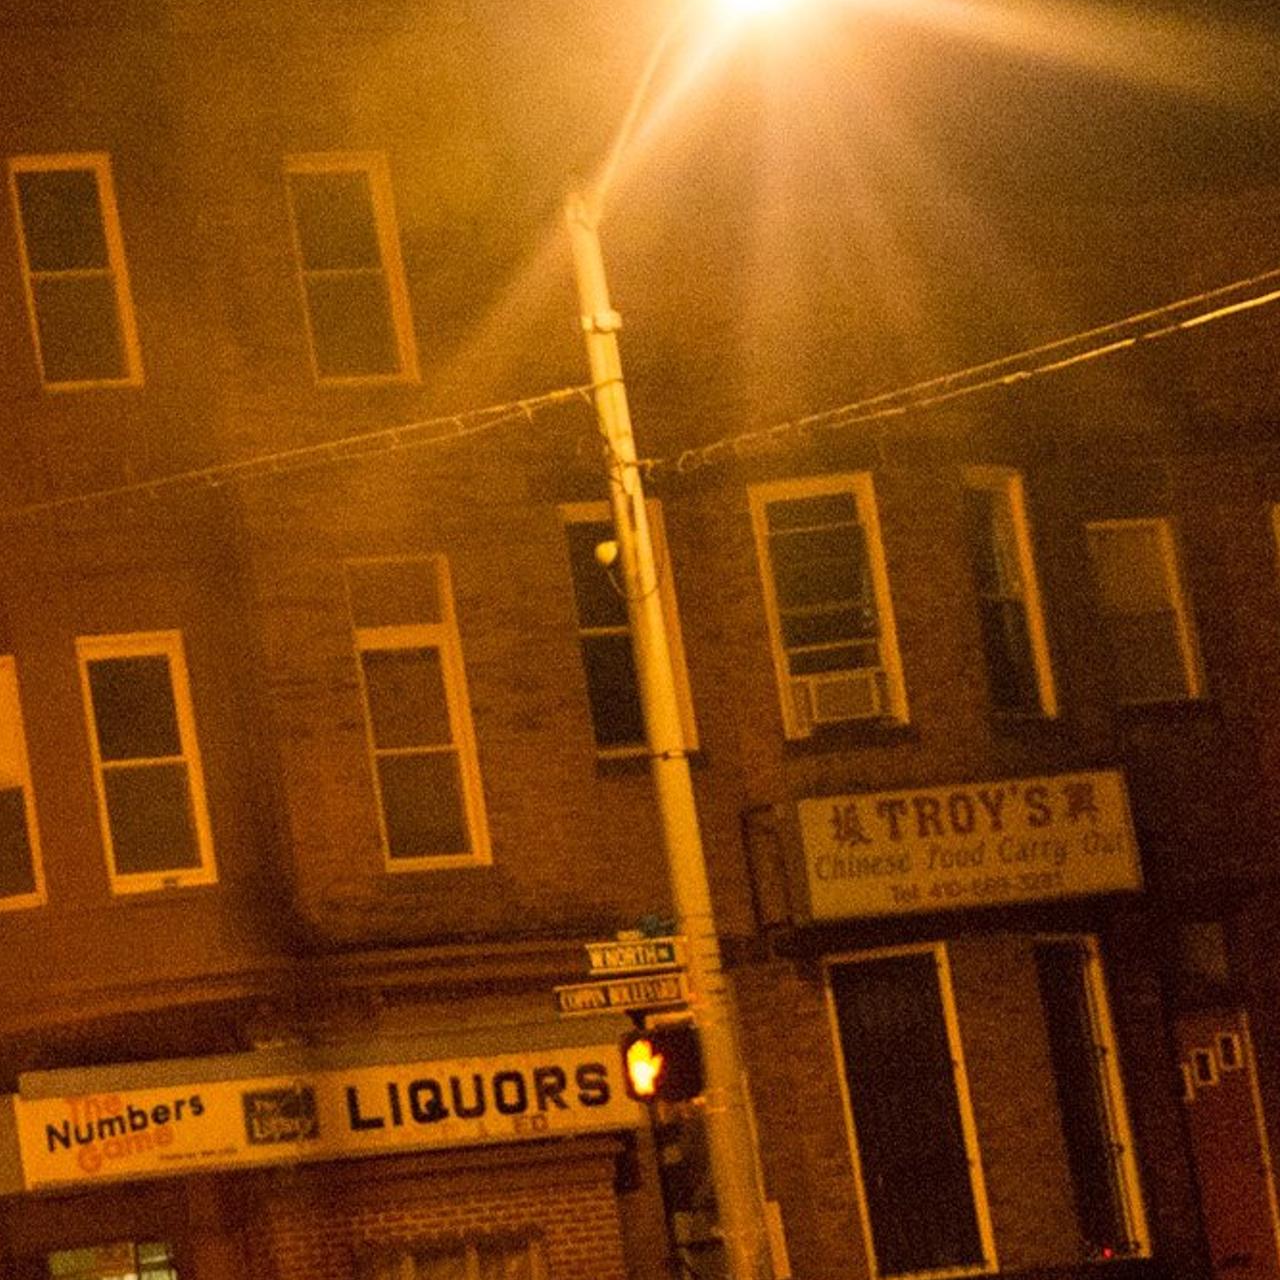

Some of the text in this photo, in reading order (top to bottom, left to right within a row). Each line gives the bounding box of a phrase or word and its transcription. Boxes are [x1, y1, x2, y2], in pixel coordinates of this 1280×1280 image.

[876, 784, 1053, 842] TROY'S
[814, 850, 913, 883] Chinese
[997, 834, 1069, 867] Carry
[45, 1094, 206, 1153] Numbers
[346, 1063, 611, 1131] LIQUORS
[77, 1123, 174, 1173] Game
